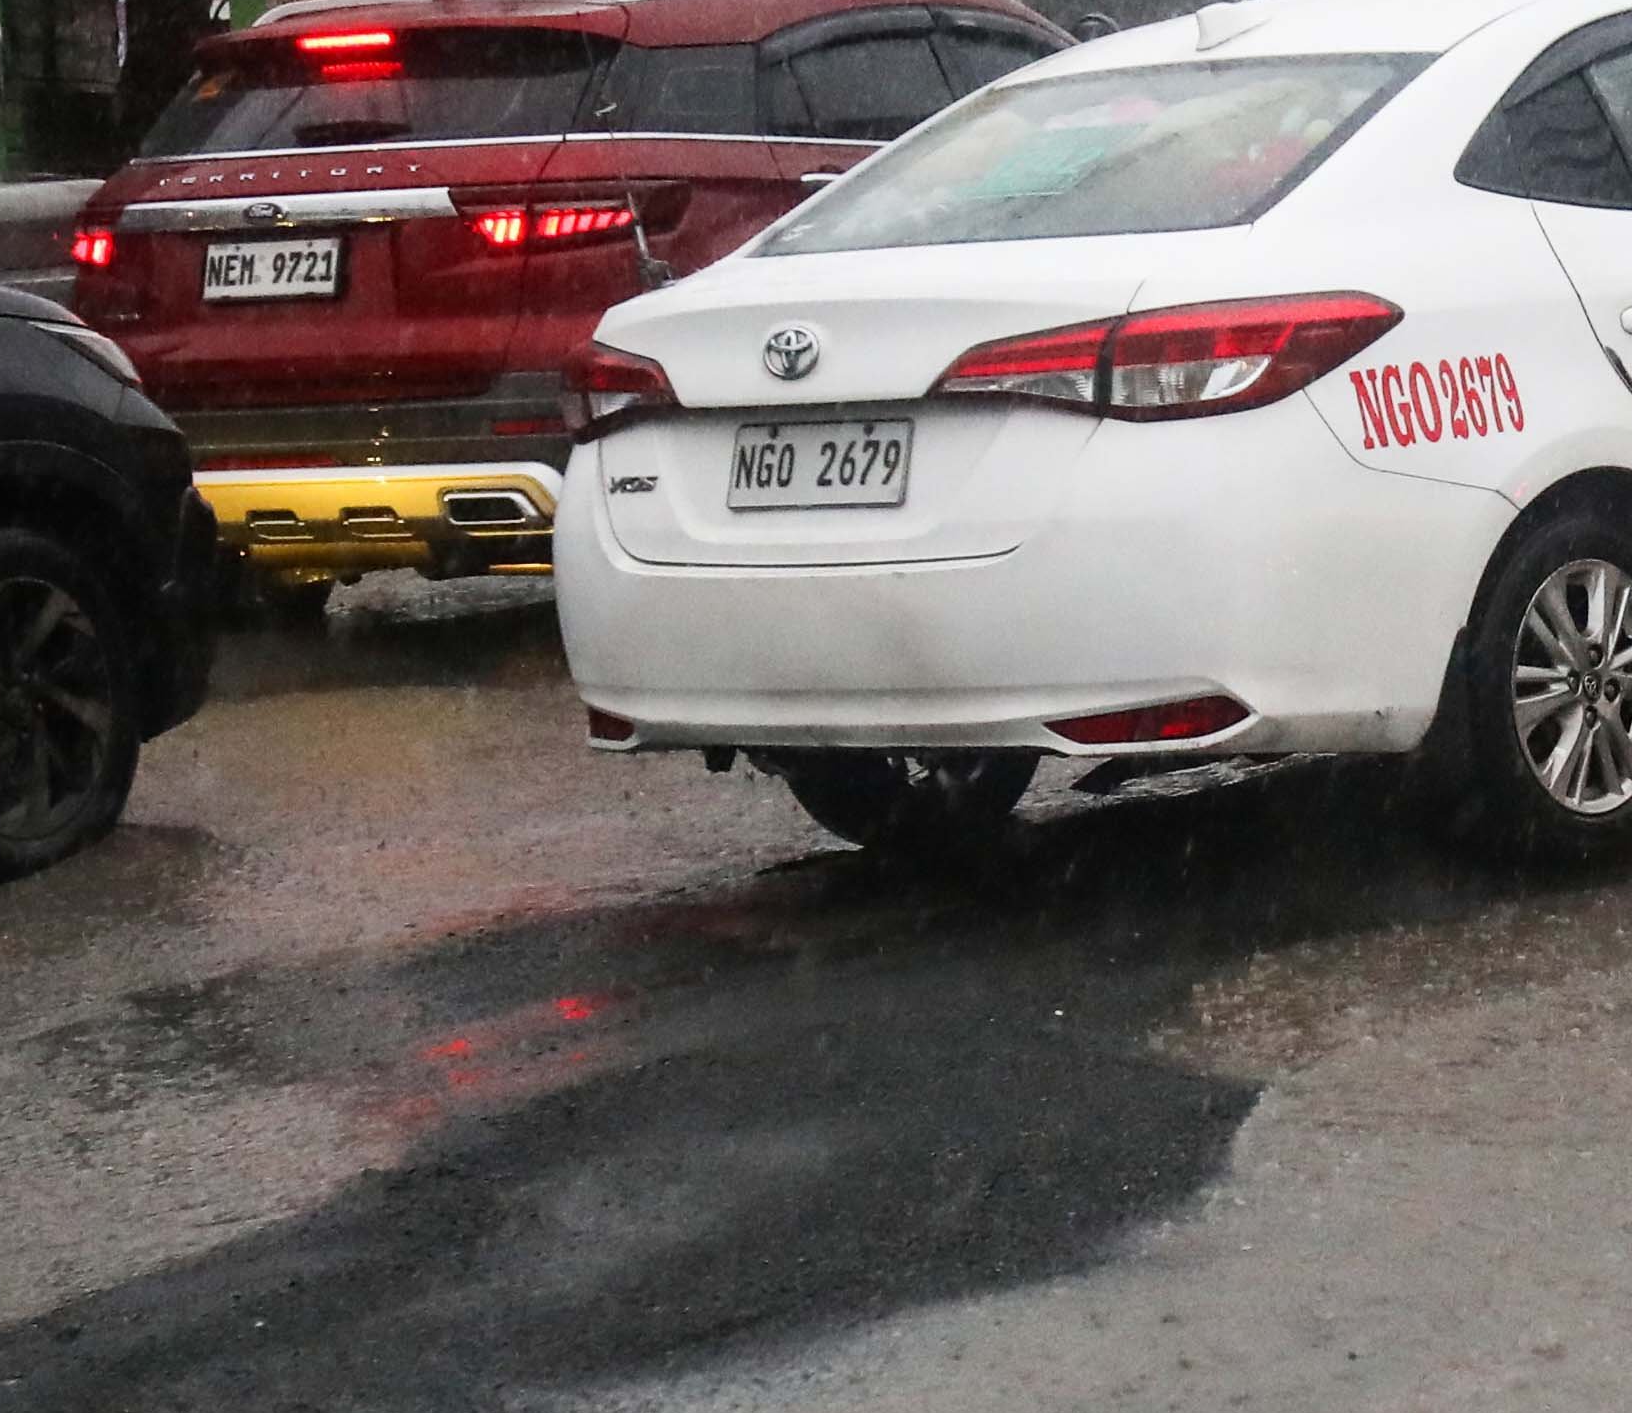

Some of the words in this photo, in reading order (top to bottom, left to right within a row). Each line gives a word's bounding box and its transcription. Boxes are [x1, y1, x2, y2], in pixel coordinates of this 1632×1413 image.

[207, 253, 256, 288] NEM
[272, 249, 334, 285] 9721
[734, 443, 795, 491] NGO
[817, 438, 901, 486] 2679
